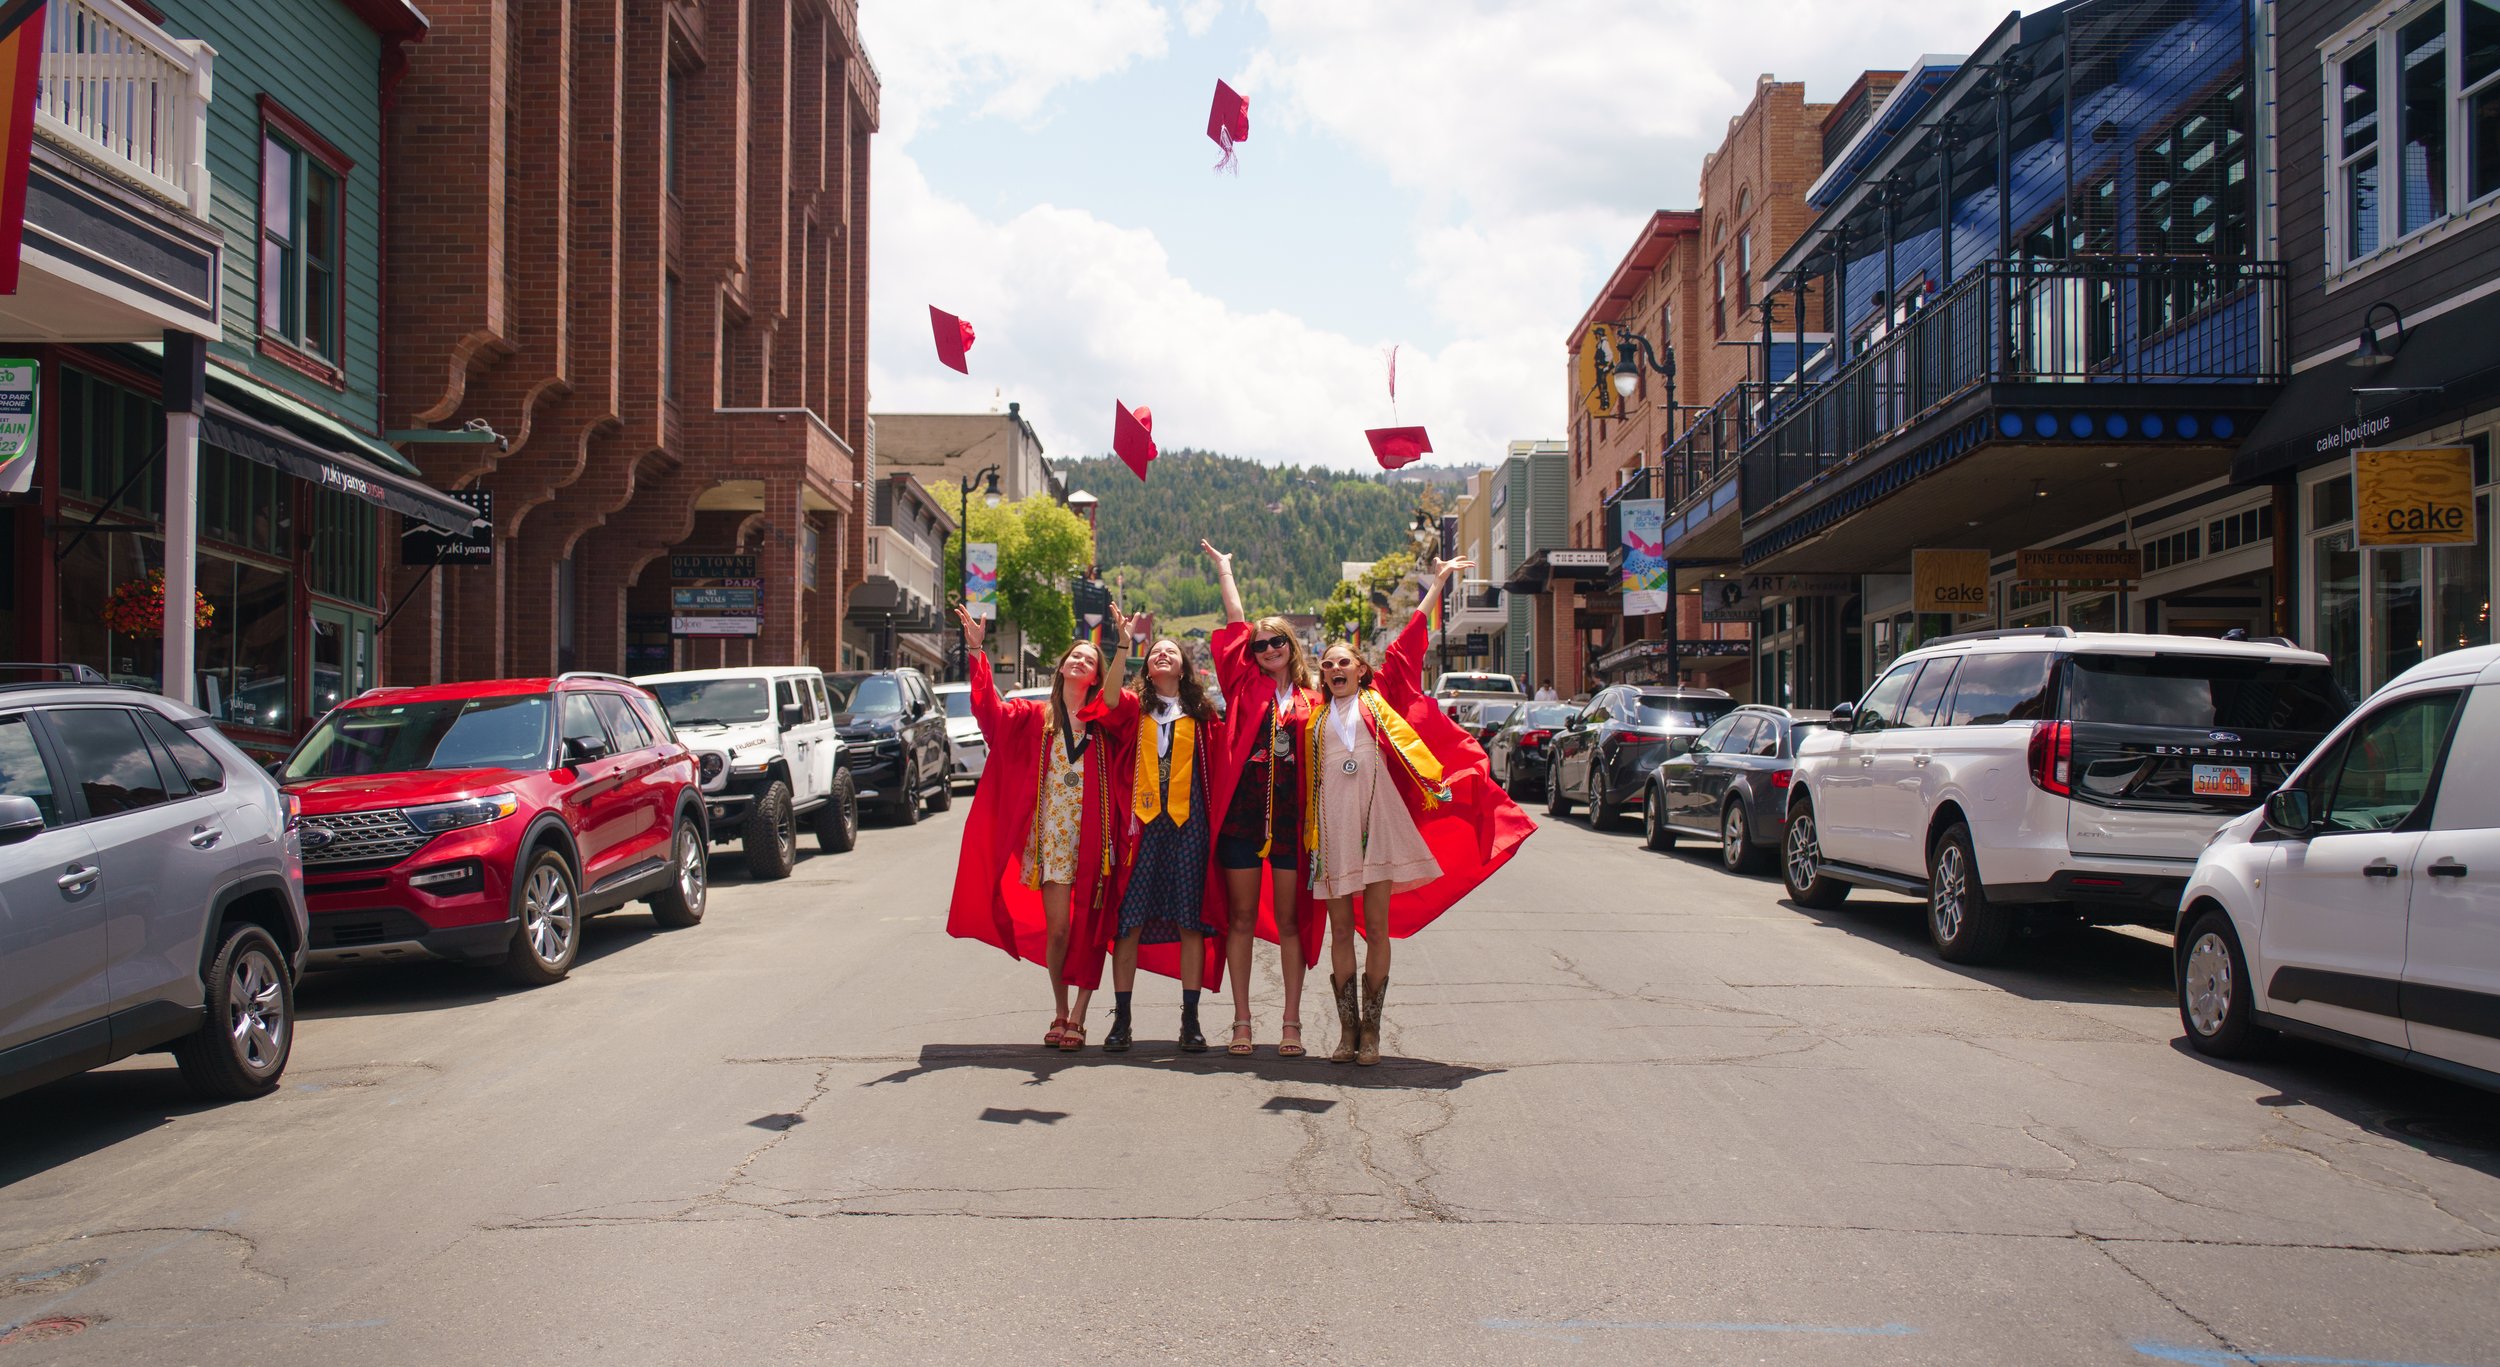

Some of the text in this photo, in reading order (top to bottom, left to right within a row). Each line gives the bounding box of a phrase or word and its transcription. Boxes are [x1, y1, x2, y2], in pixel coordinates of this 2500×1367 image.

[0, 441, 17, 451] 23
[320, 463, 341, 485] yuki
[2387, 502, 2464, 530] cake
[464, 546, 490, 556] yama
[673, 557, 753, 567] OLD TOWNE
[1554, 554, 1573, 563] THE
[2024, 553, 2136, 565] PINE CONE RIDGE
[674, 568, 754, 577] GALLERY
[725, 579, 760, 589] PARK
[1748, 576, 1784, 591] ART
[1935, 584, 1984, 601] cake
[735, 738, 767, 750] RUBICON
[2155, 746, 2297, 760] EXPEDITION
